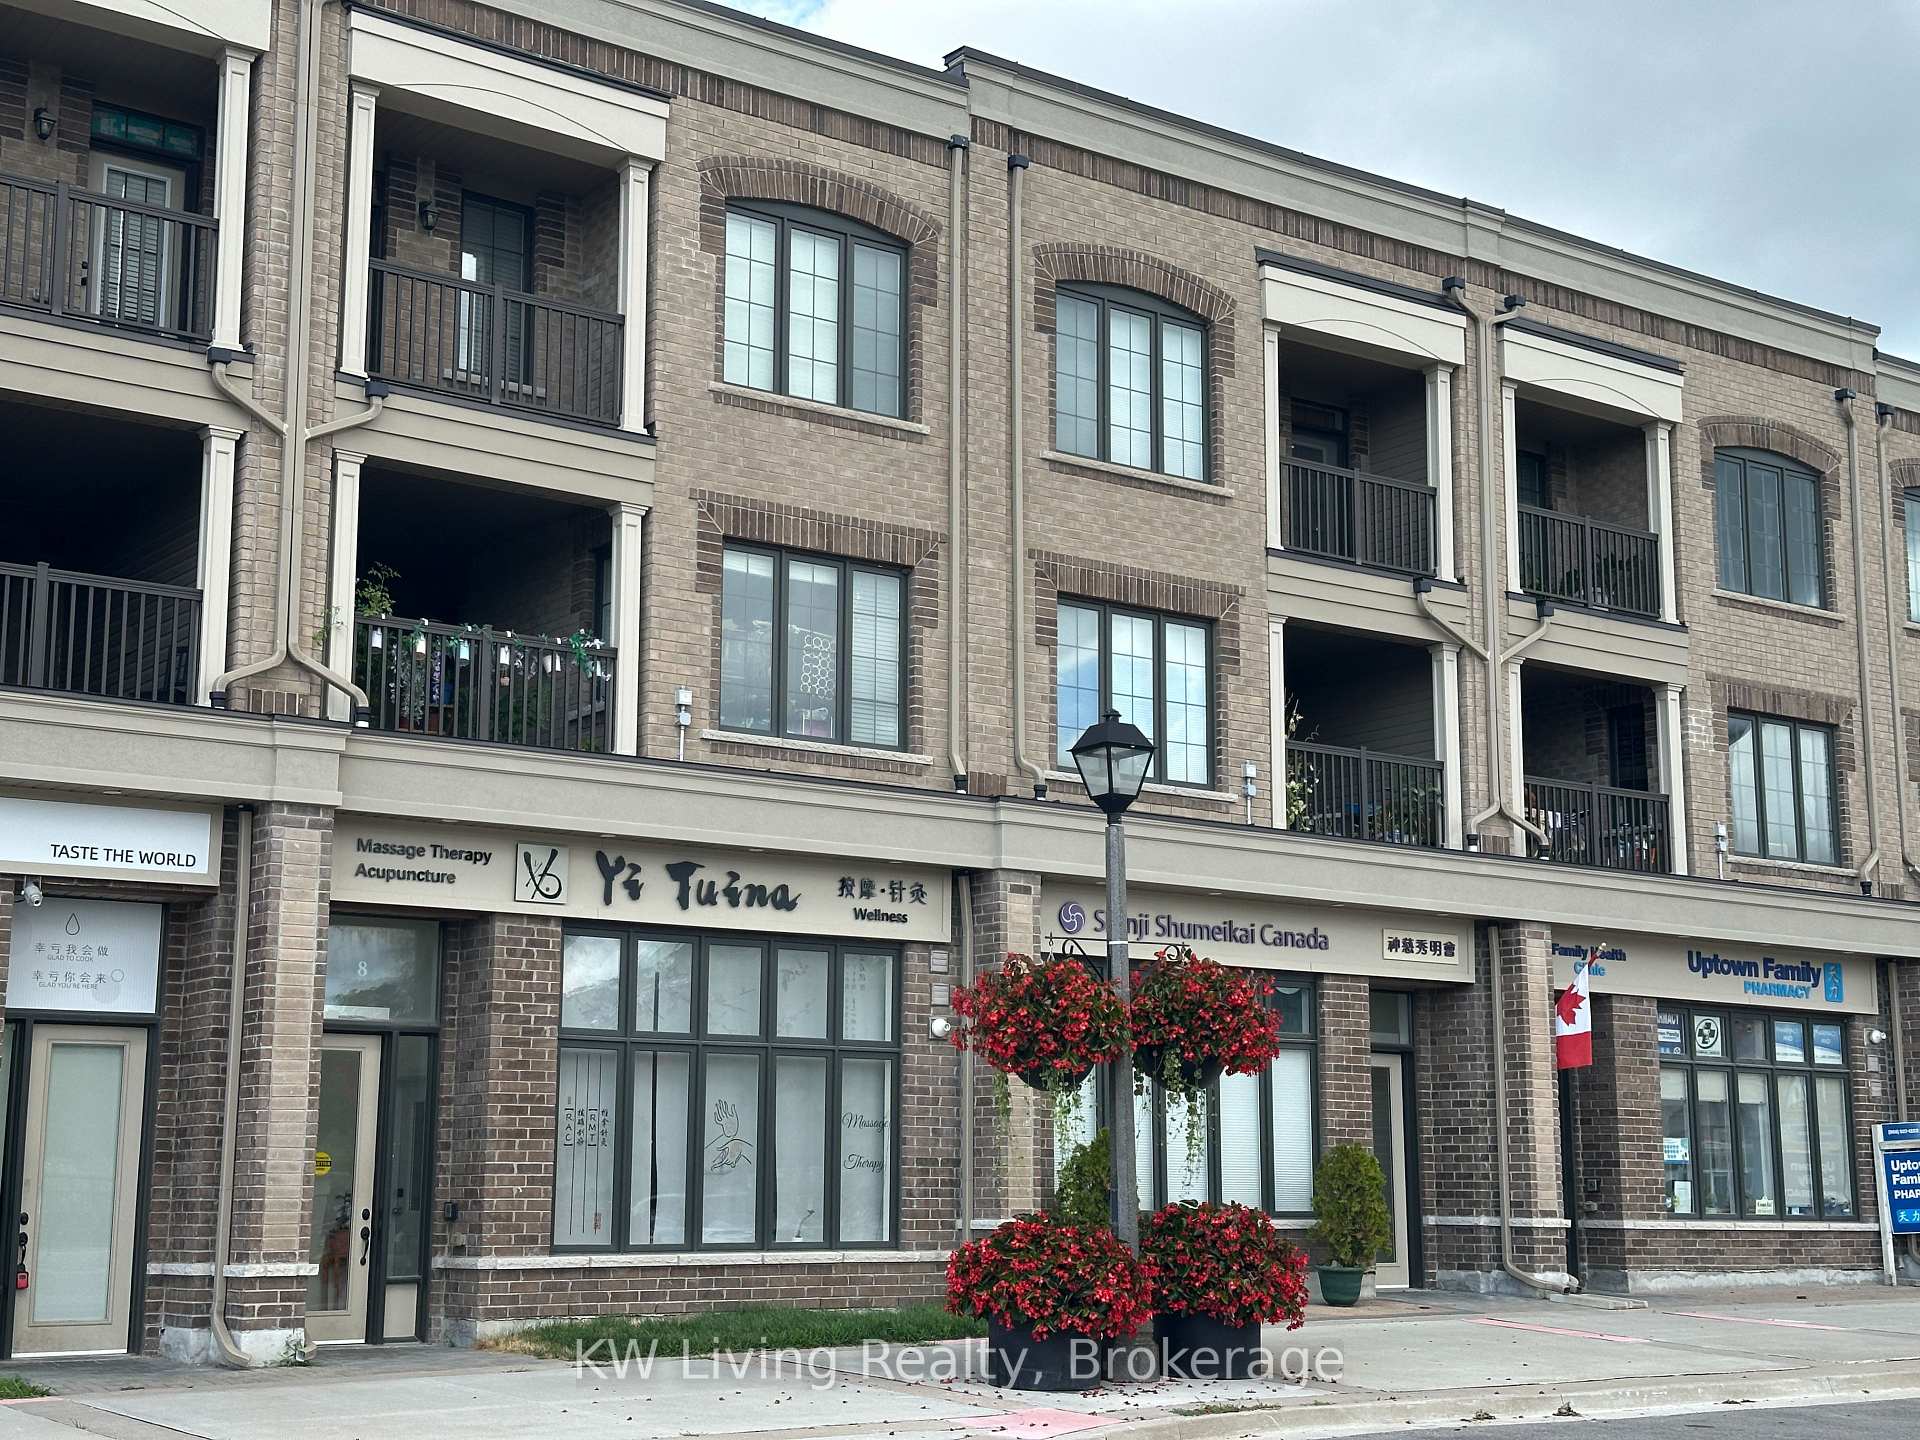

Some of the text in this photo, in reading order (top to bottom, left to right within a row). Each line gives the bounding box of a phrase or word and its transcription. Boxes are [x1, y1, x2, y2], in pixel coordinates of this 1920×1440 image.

[50, 844, 196, 867] TASTE THE WORLD
[356, 838, 493, 866] Massage Therapy
[354, 862, 457, 884] Acupuncture
[853, 907, 908, 923] Wellness
[1094, 909, 1330, 950] Snji Shumeikai Canada
[1551, 943, 1588, 961] Family
[358, 960, 367, 977] 8
[1574, 961, 1606, 977] Cnic
[1688, 950, 1822, 988] Uptown Family
[1743, 980, 1812, 999] PHARMACY
[842, 1111, 889, 1133] Massage
[844, 1153, 884, 1173] Therapy
[1890, 1159, 1920, 1173] Upto
